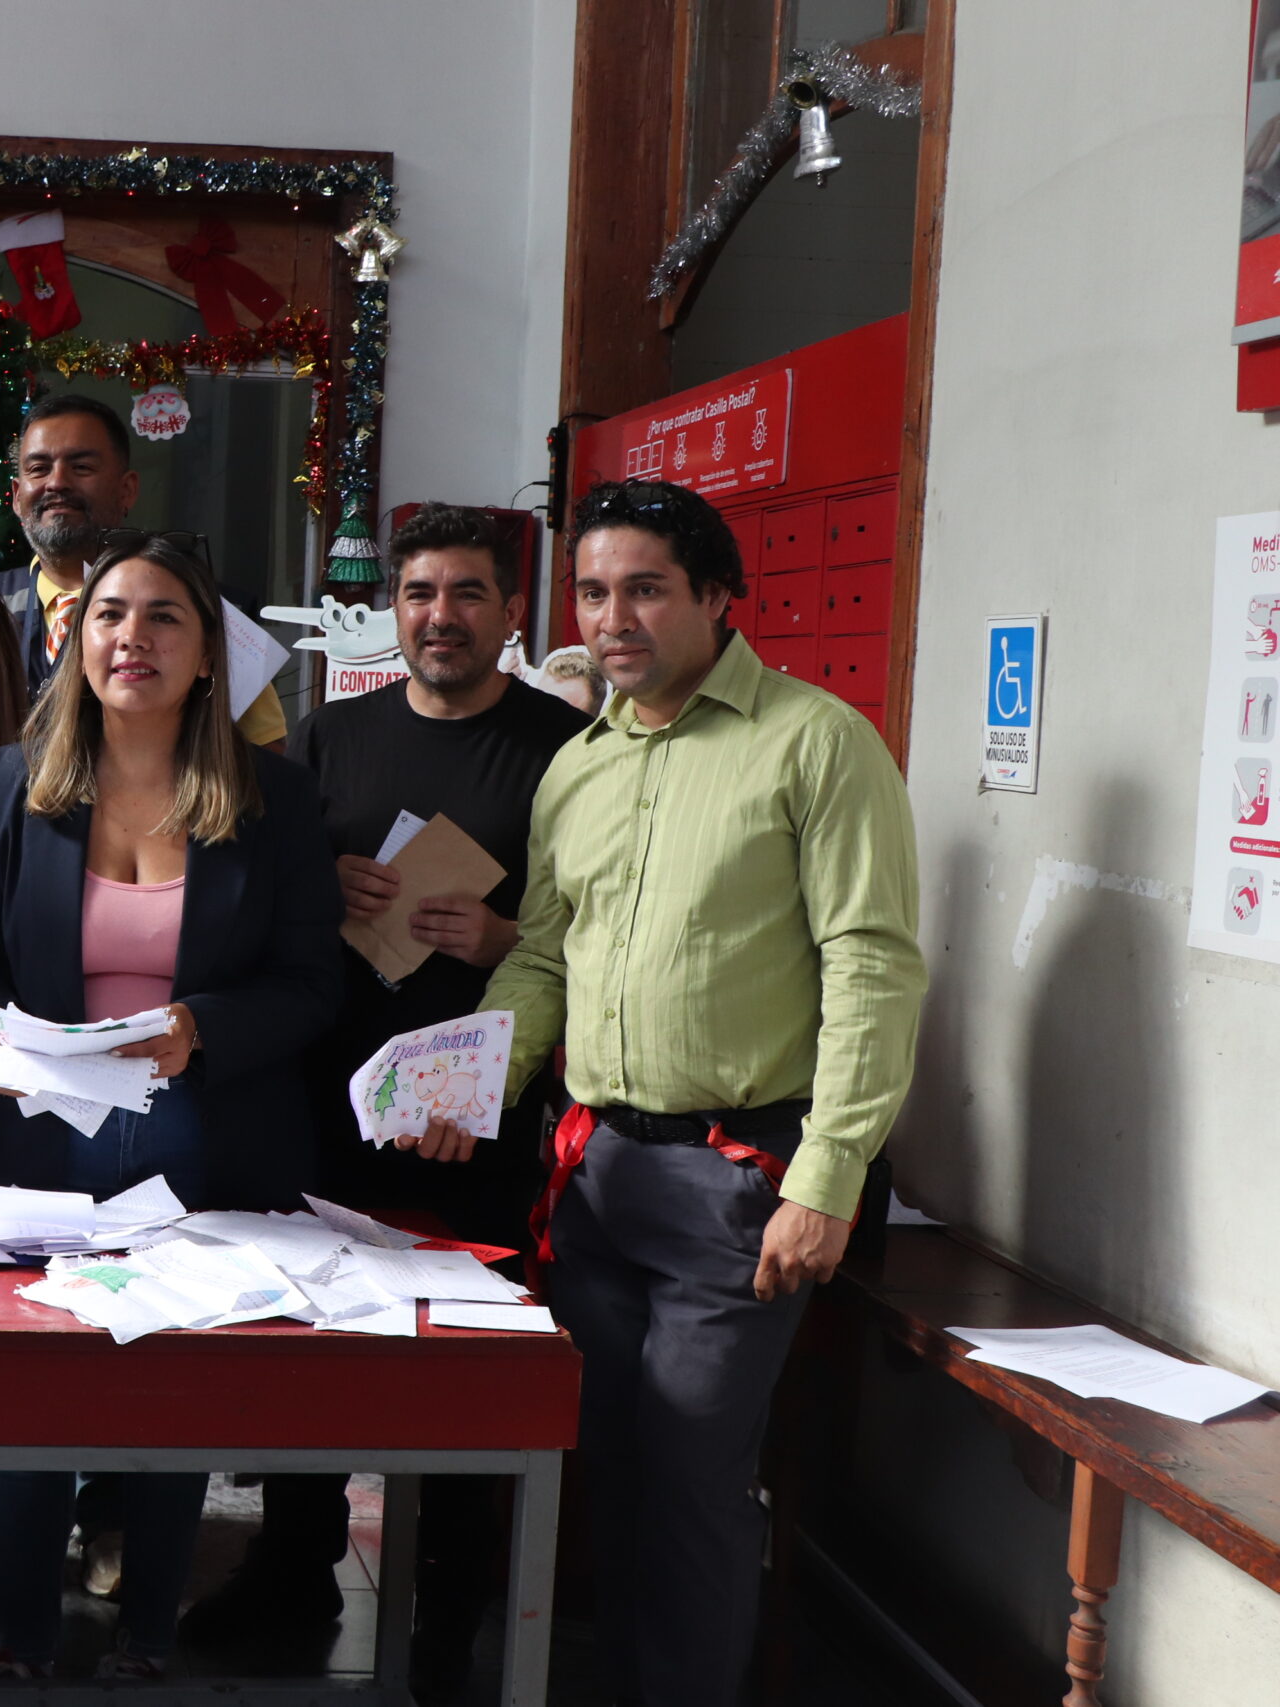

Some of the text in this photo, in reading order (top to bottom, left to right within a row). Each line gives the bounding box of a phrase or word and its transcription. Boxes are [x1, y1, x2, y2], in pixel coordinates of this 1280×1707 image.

[662, 418, 674, 435] que
[674, 406, 704, 428] contratar
[705, 398, 728, 418] Casilla
[728, 386, 756, 411] Postal?
[990, 731, 1026, 747] SOLO USO DE
[426, 1030, 485, 1053] NAVIDAD
